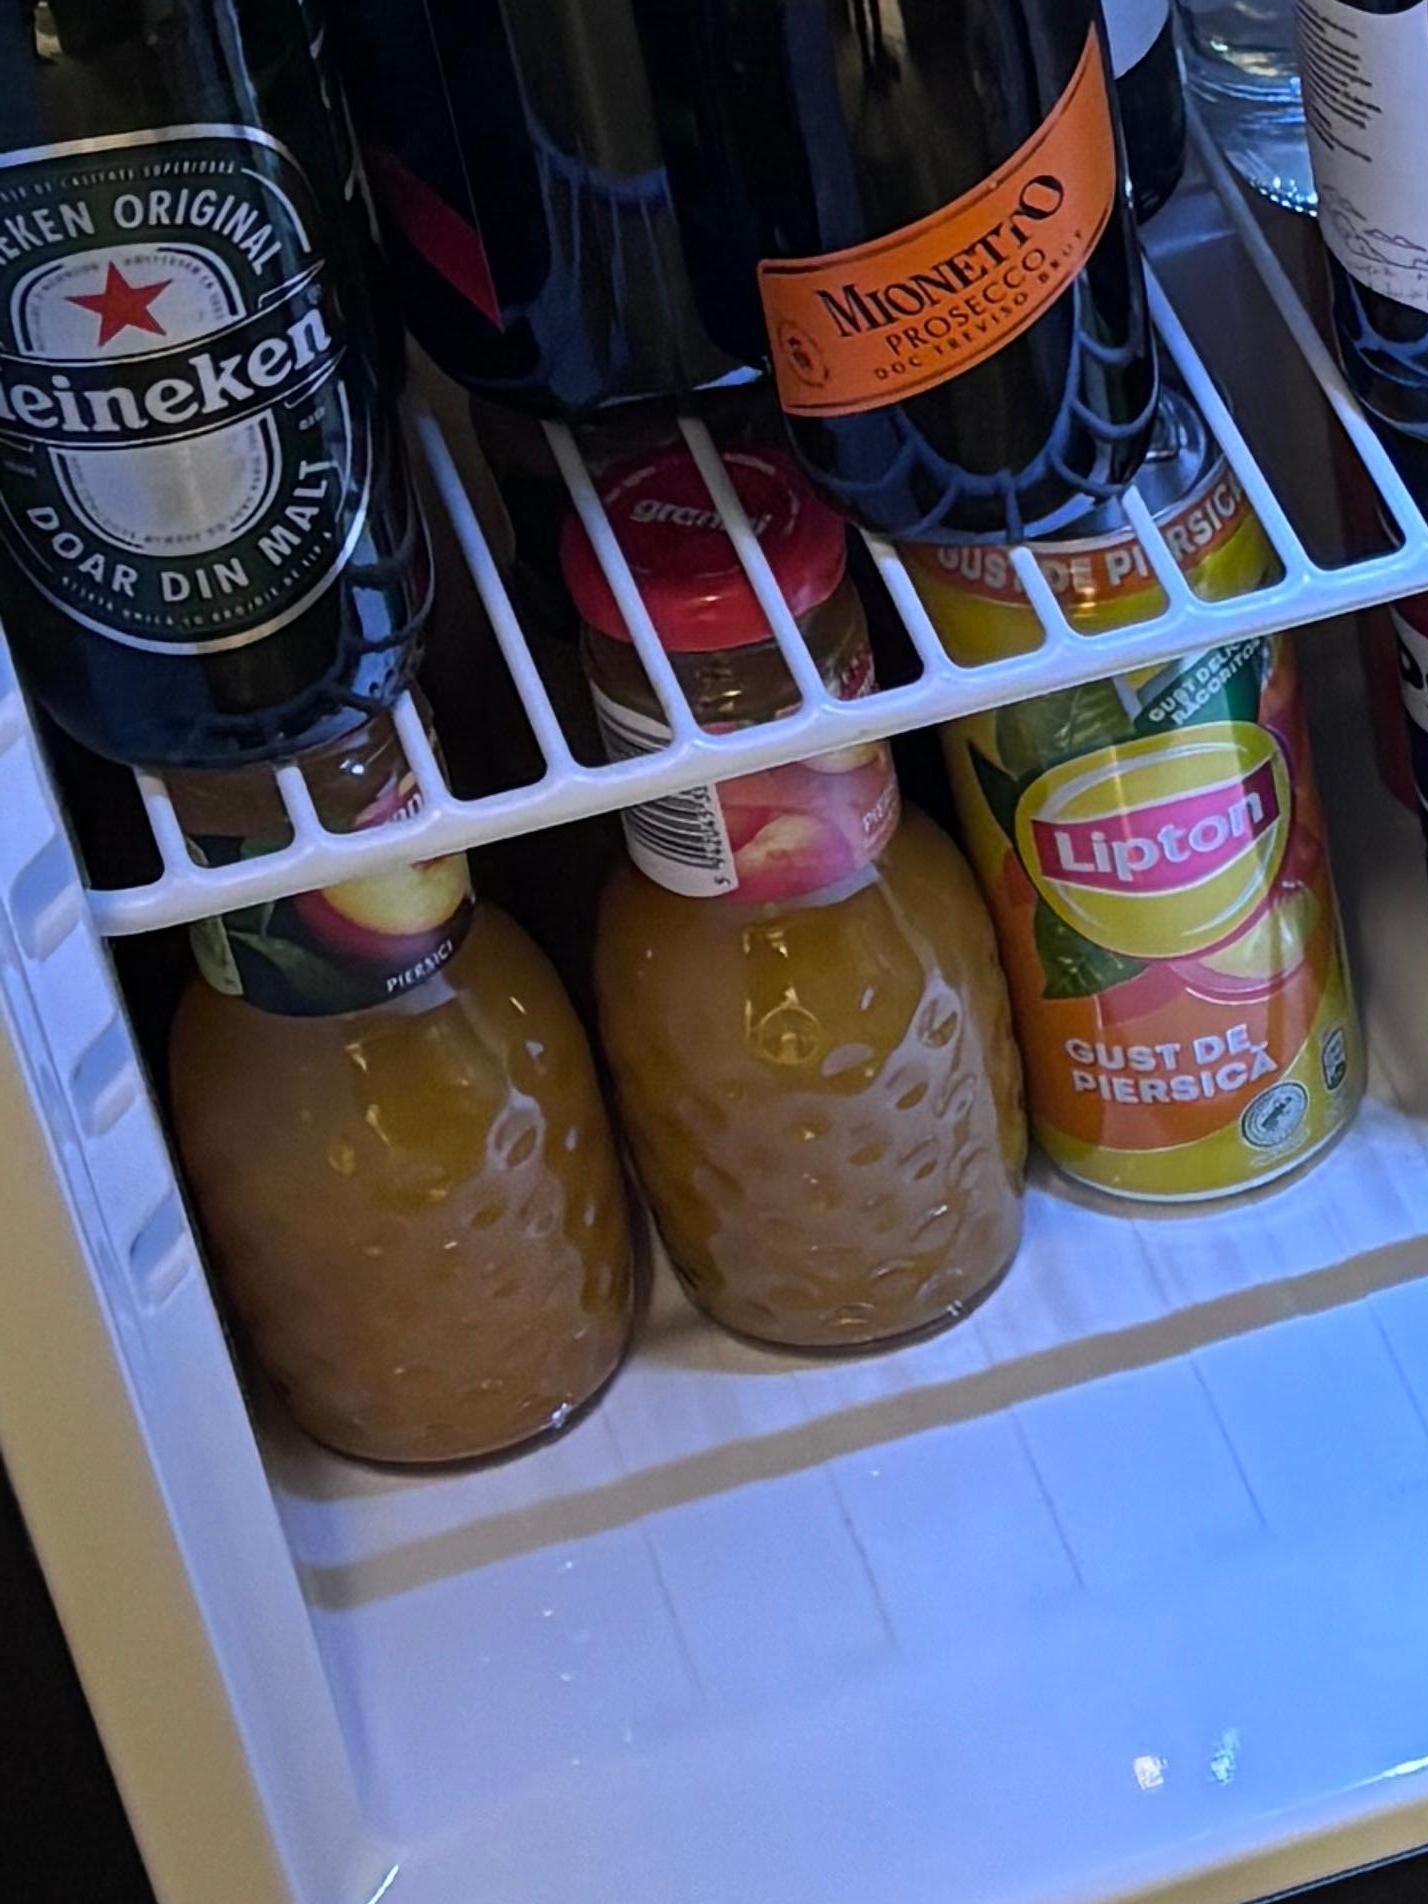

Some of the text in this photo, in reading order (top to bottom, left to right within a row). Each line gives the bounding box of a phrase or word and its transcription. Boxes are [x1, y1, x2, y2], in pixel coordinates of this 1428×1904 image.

[113, 187, 283, 277] ORIGINAL
[885, 247, 1047, 355] PROSECCO
[26, 506, 138, 597] DOAR
[160, 557, 250, 603] DIN
[257, 459, 338, 567] MALT
[1053, 788, 1265, 881] Lipton
[386, 939, 454, 993] PIERSICI
[1065, 1022, 1251, 1075] GUST DE
[1072, 1040, 1279, 1105] PIERSICĂ
